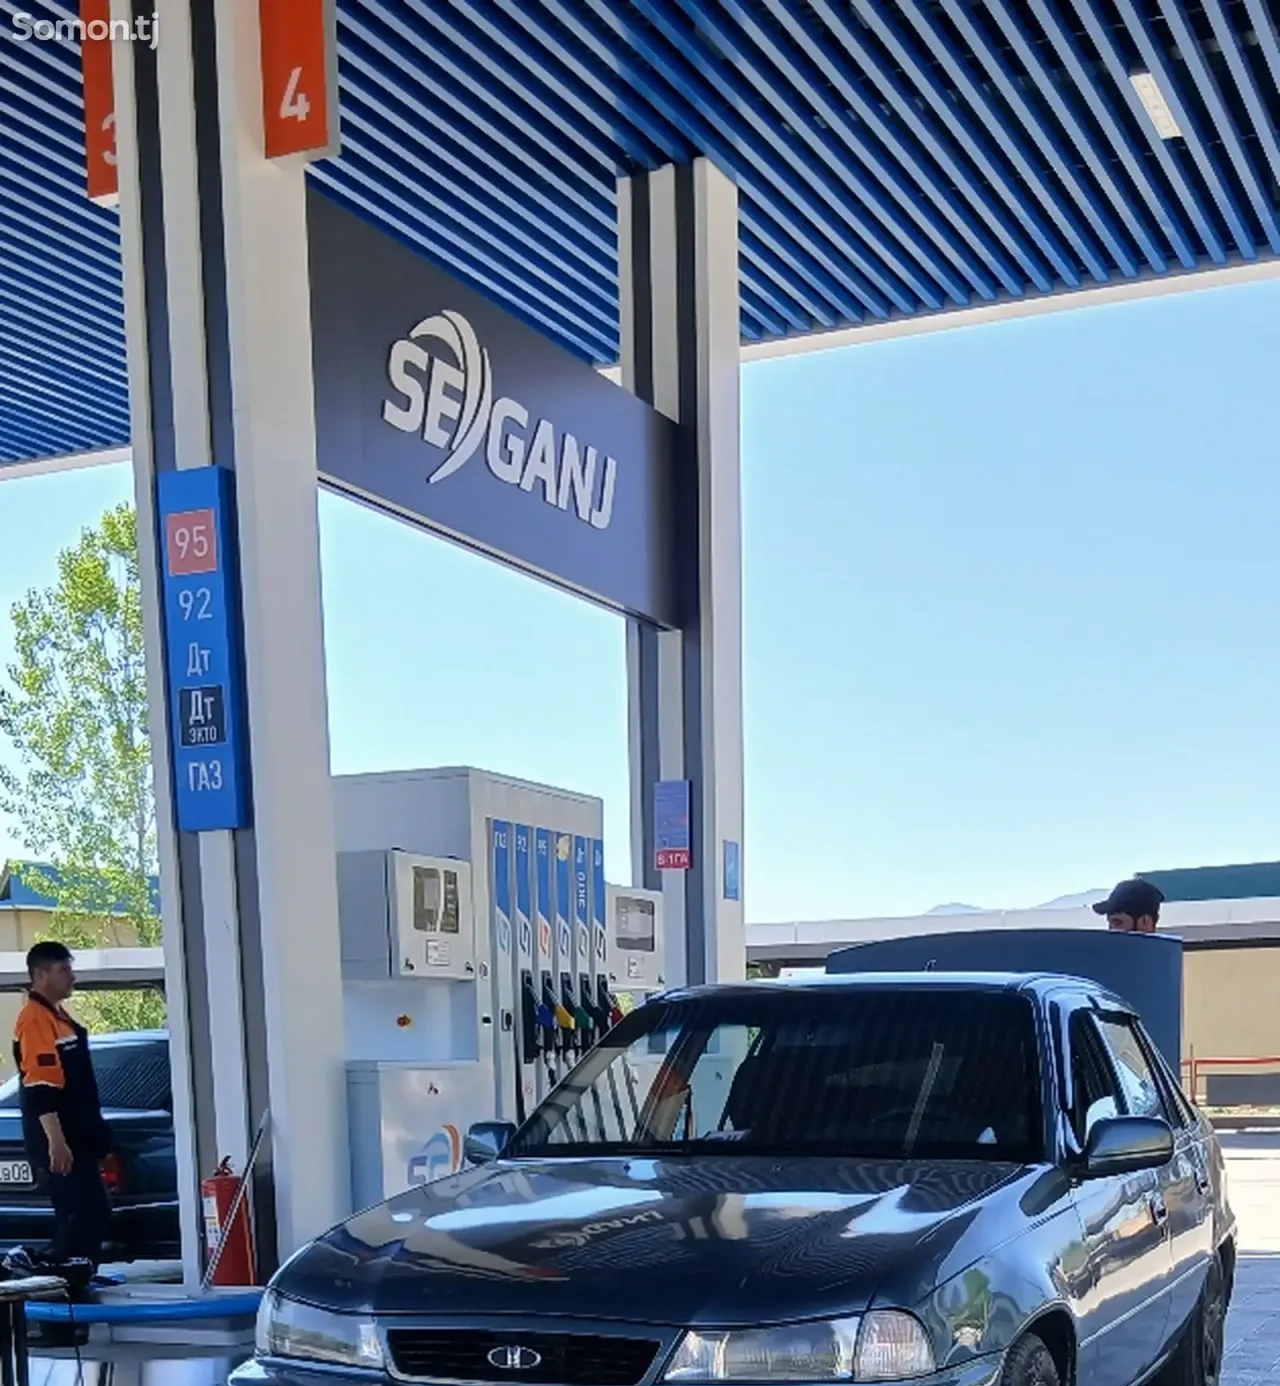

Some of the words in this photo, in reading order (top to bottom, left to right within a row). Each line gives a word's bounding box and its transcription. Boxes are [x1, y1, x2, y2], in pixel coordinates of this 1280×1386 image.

[279, 66, 310, 122] 4
[174, 525, 208, 559] 95
[178, 587, 213, 621] 92
[186, 642, 211, 677] Дт
[189, 690, 215, 725] Дт
[188, 759, 223, 792] ГАЗ
